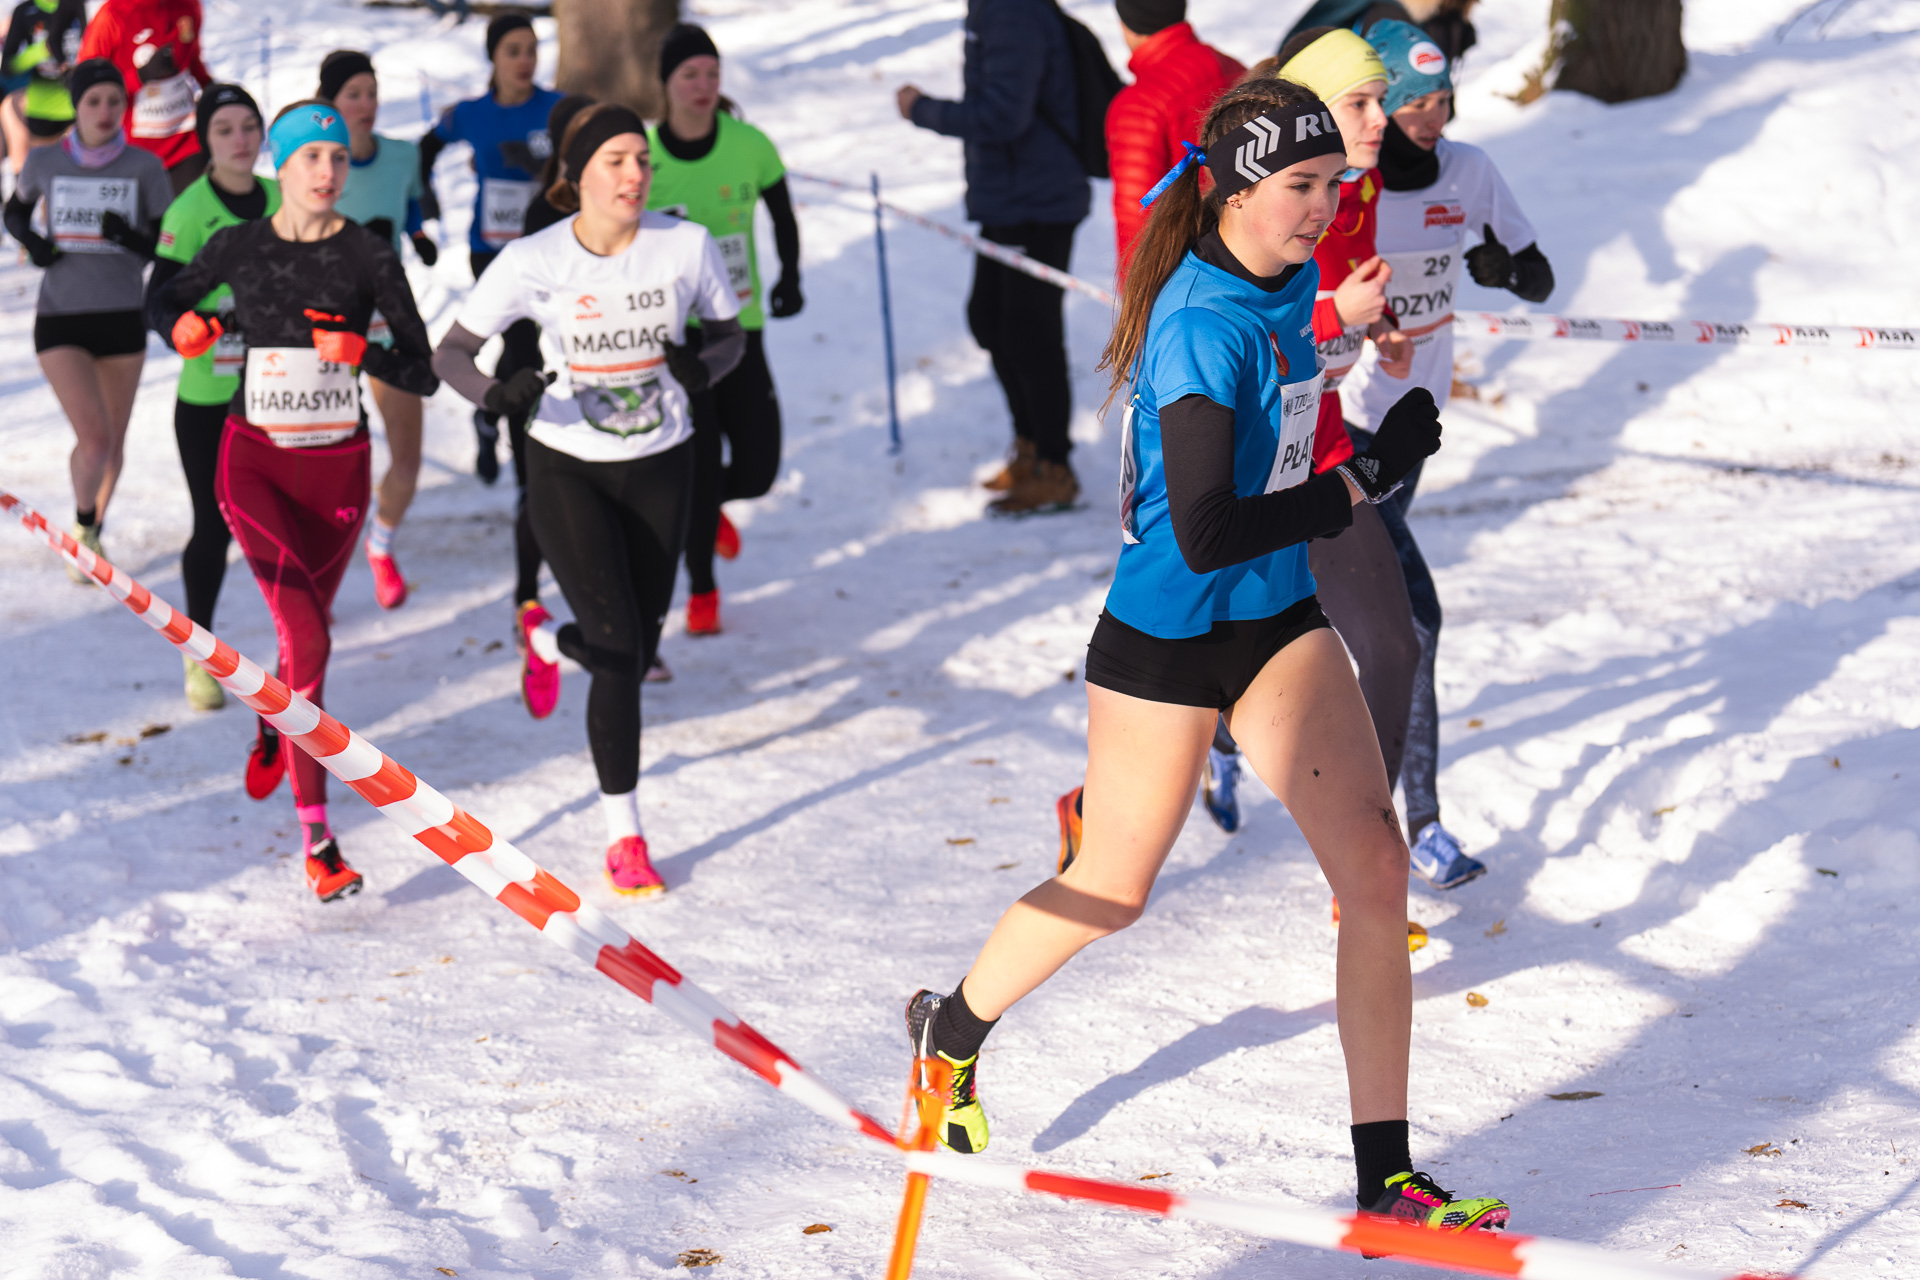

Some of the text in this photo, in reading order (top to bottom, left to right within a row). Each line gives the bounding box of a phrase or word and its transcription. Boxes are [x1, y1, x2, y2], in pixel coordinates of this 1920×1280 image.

[1424, 255, 1451, 277] 29
[625, 288, 667, 312] 103
[1386, 281, 1454, 316] DZYŃ
[572, 324, 669, 355] MACIĄG
[251, 388, 354, 412] HARASYM
[1294, 393, 1308, 410] 770
[1354, 457, 1378, 484] adidas
